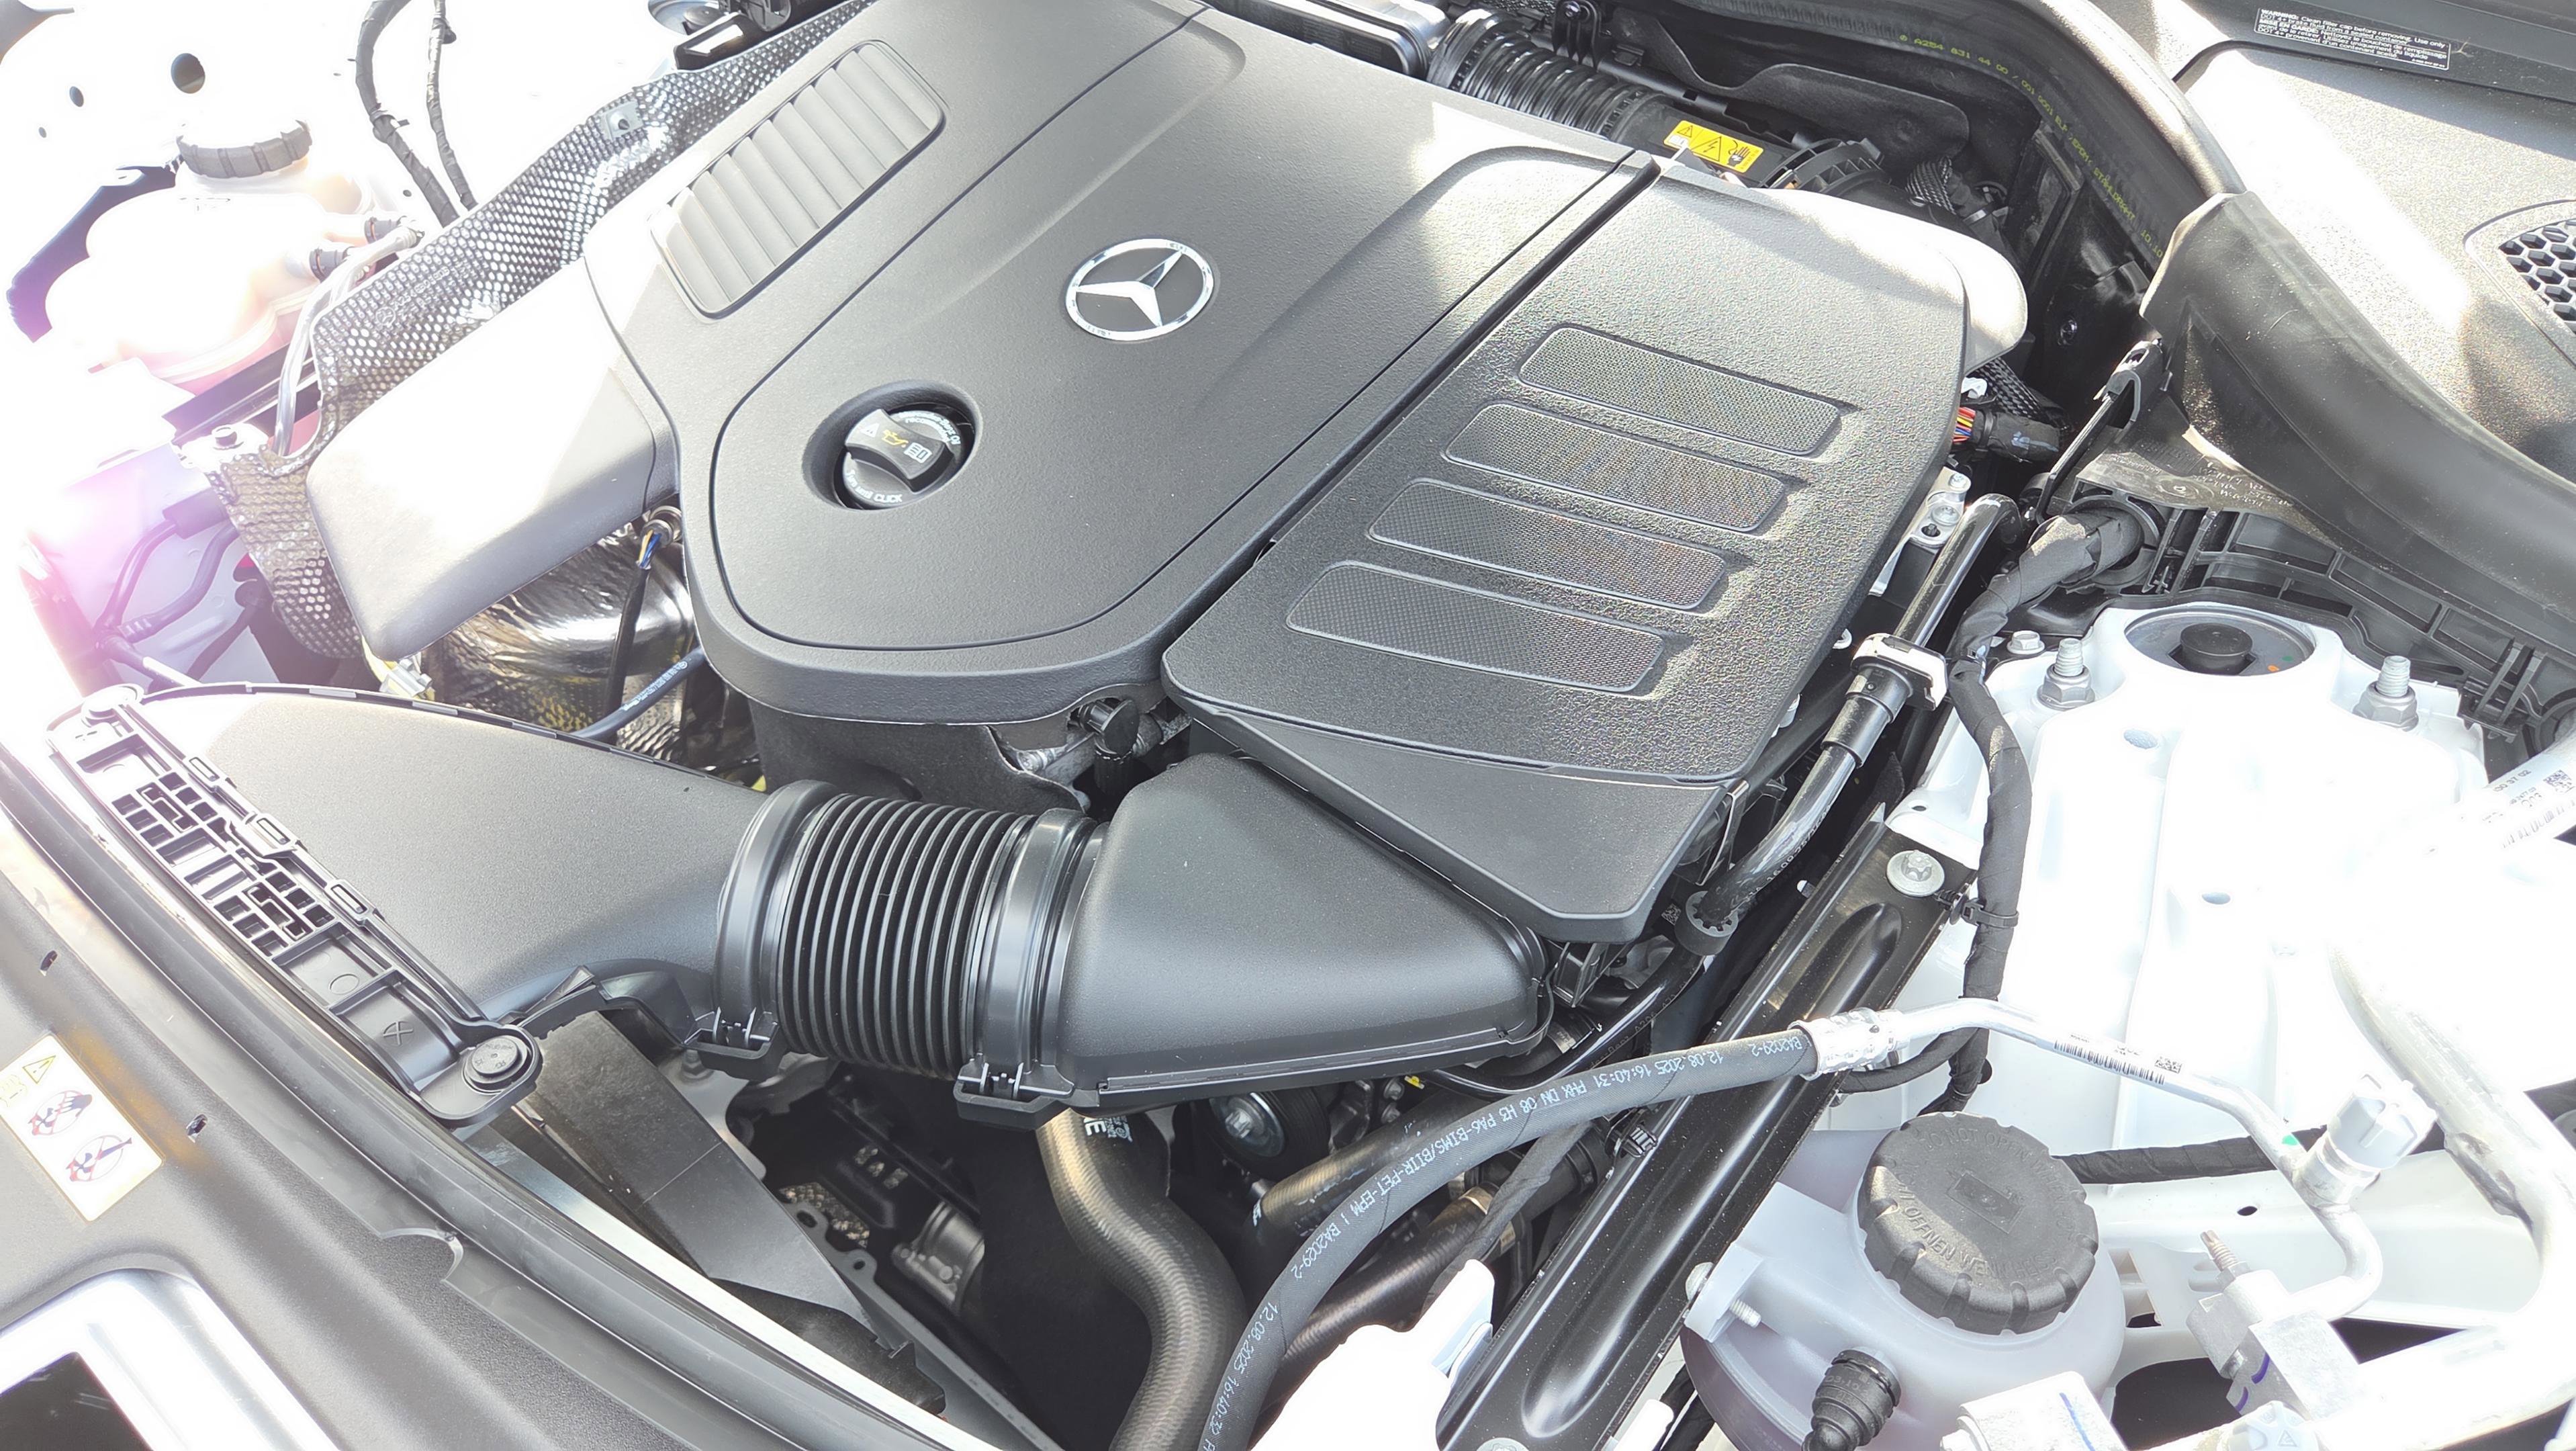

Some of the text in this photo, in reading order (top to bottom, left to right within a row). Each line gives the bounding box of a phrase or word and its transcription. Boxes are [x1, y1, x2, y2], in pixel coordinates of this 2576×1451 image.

[2261, 9, 2299, 20] WARNING:
[2301, 15, 2321, 24] Clean
[2323, 19, 2338, 28] filler
[2354, 26, 2377, 35] before
[2378, 30, 2413, 42] removing.
[2414, 36, 2429, 45] Use
[2430, 41, 2446, 49] only
[2288, 17, 2309, 27] brake
[2309, 22, 2325, 30] fluid
[2351, 30, 2375, 38] sealed
[2259, 19, 2278, 27] MISE
[2291, 24, 2319, 34] GARDE:
[2320, 30, 2352, 41] Nettoyez
[2361, 37, 2392, 48] bouchon
[2403, 46, 2448, 60] remplissage
[2285, 33, 2321, 44] provenant
[2339, 42, 2375, 54] contenant
[2323, 34, 2350, 45] Utilisez
[2350, 40, 2393, 54] uniquement
[2404, 50, 2429, 60] liquide
[1996, 64, 2008, 75] 00
[873, 493, 903, 503] CLICK
[1749, 1035, 1803, 1057] BA2029-2
[1654, 1049, 1724, 1075] 12.08.2025
[1592, 1063, 1652, 1088] 16:40:31
[1539, 1088, 1561, 1106] DN
[1498, 1104, 1518, 1123] H3
[1291, 1222, 1341, 1279] BA2029-2
[1234, 1301, 1279, 1374] 12.08.2025
